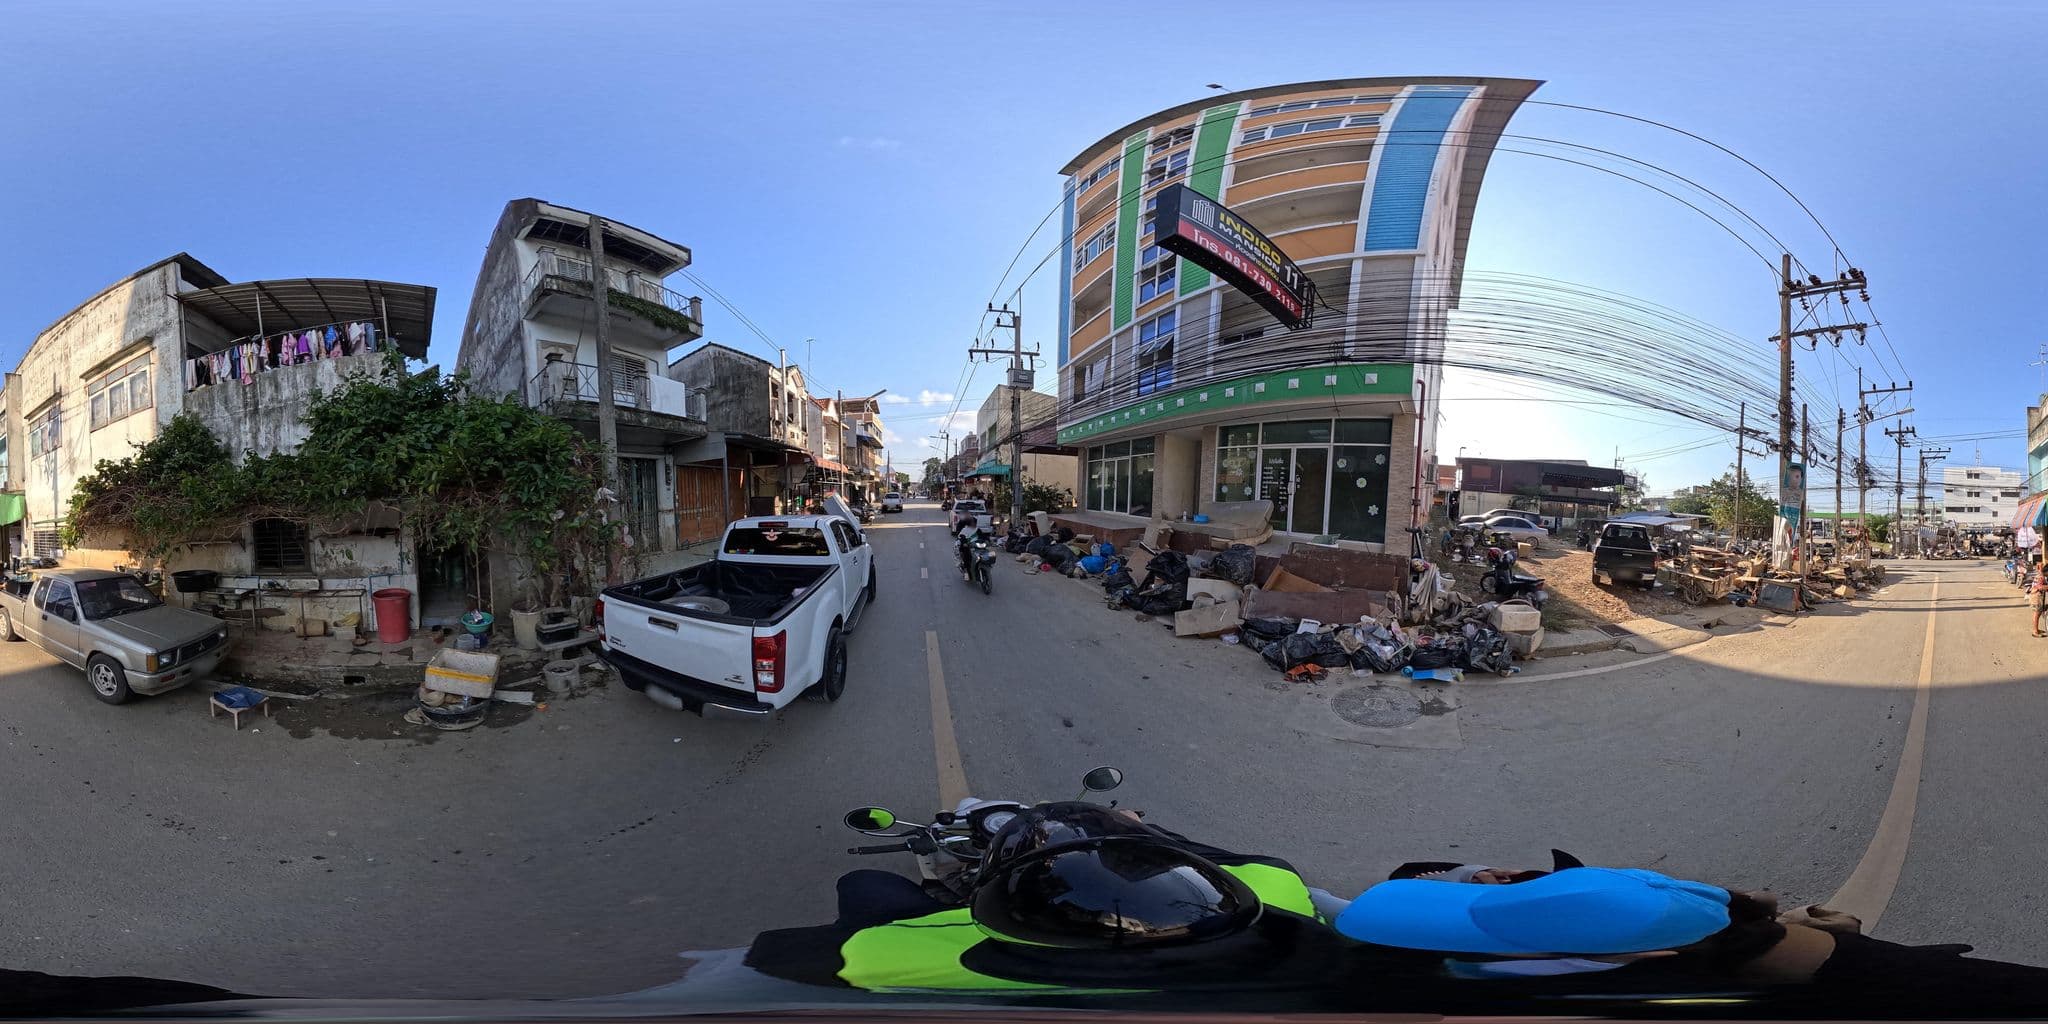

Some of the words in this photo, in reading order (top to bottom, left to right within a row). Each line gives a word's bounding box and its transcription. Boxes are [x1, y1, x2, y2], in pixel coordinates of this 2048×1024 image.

[1219, 212, 1282, 265] INDIGO
[1219, 223, 1281, 273] MANSION
[1284, 264, 1298, 290] 11
